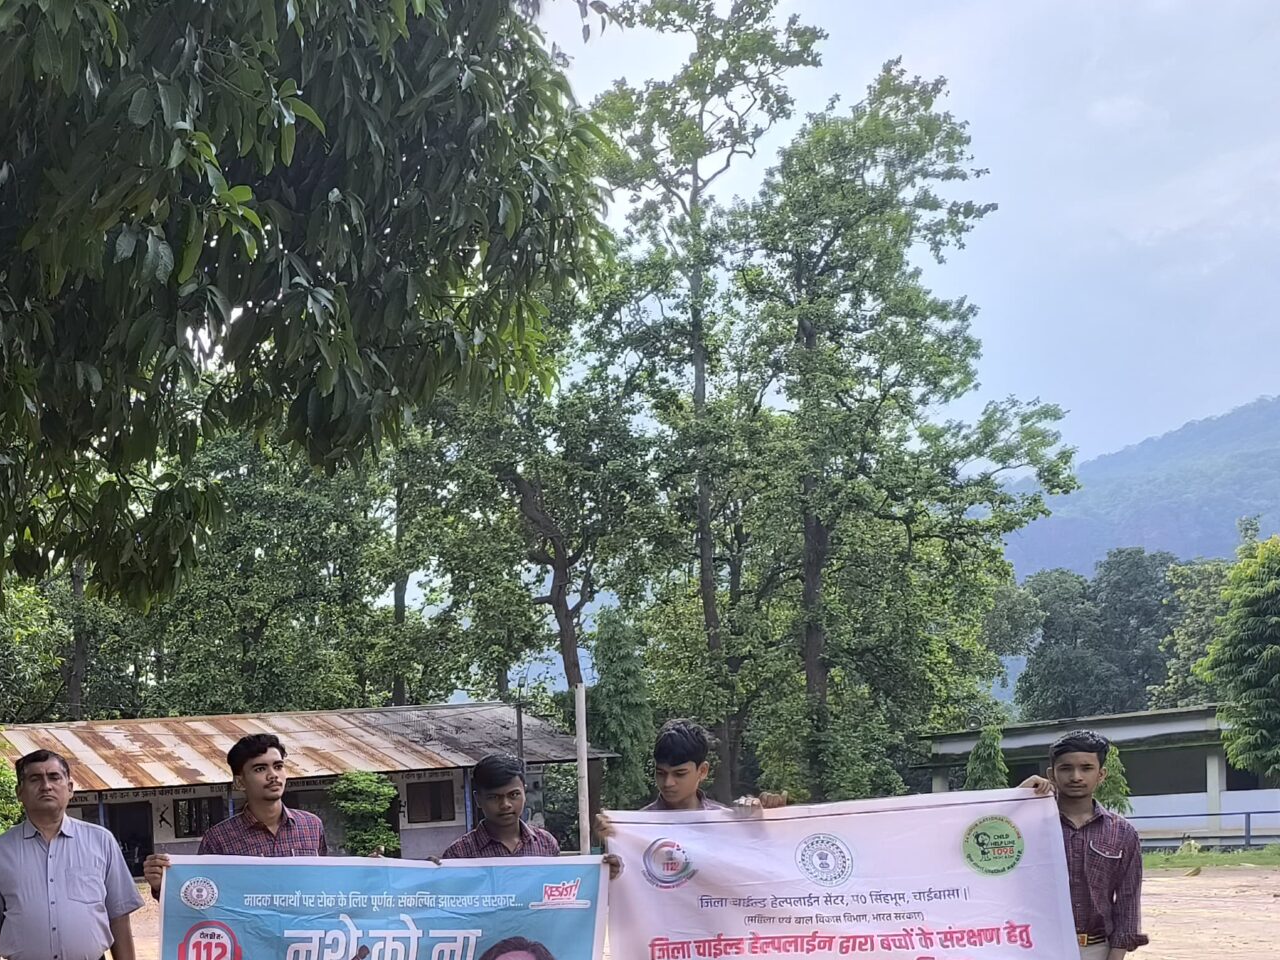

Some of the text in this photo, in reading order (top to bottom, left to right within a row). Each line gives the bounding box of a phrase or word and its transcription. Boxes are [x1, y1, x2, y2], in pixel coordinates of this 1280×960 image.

[991, 847, 1015, 856] 1098
[243, 893, 271, 908] मादक
[302, 893, 315, 908] पर
[317, 890, 337, 908] रोक
[337, 891, 347, 908] के
[348, 891, 368, 909] लिए
[699, 895, 728, 909] जिला
[770, 893, 820, 908] हेल्पलाईन
[823, 892, 849, 907] सेंटर,
[869, 890, 910, 907] सिंहभूम,
[815, 913, 842, 924] विकास
[843, 912, 870, 924] विभाग,
[872, 912, 892, 921] भारत
[649, 920, 1034, 960] जिला चाईल्ड हेल्पलाईन द्वारा बच्चों के संरक्षण हेतु
